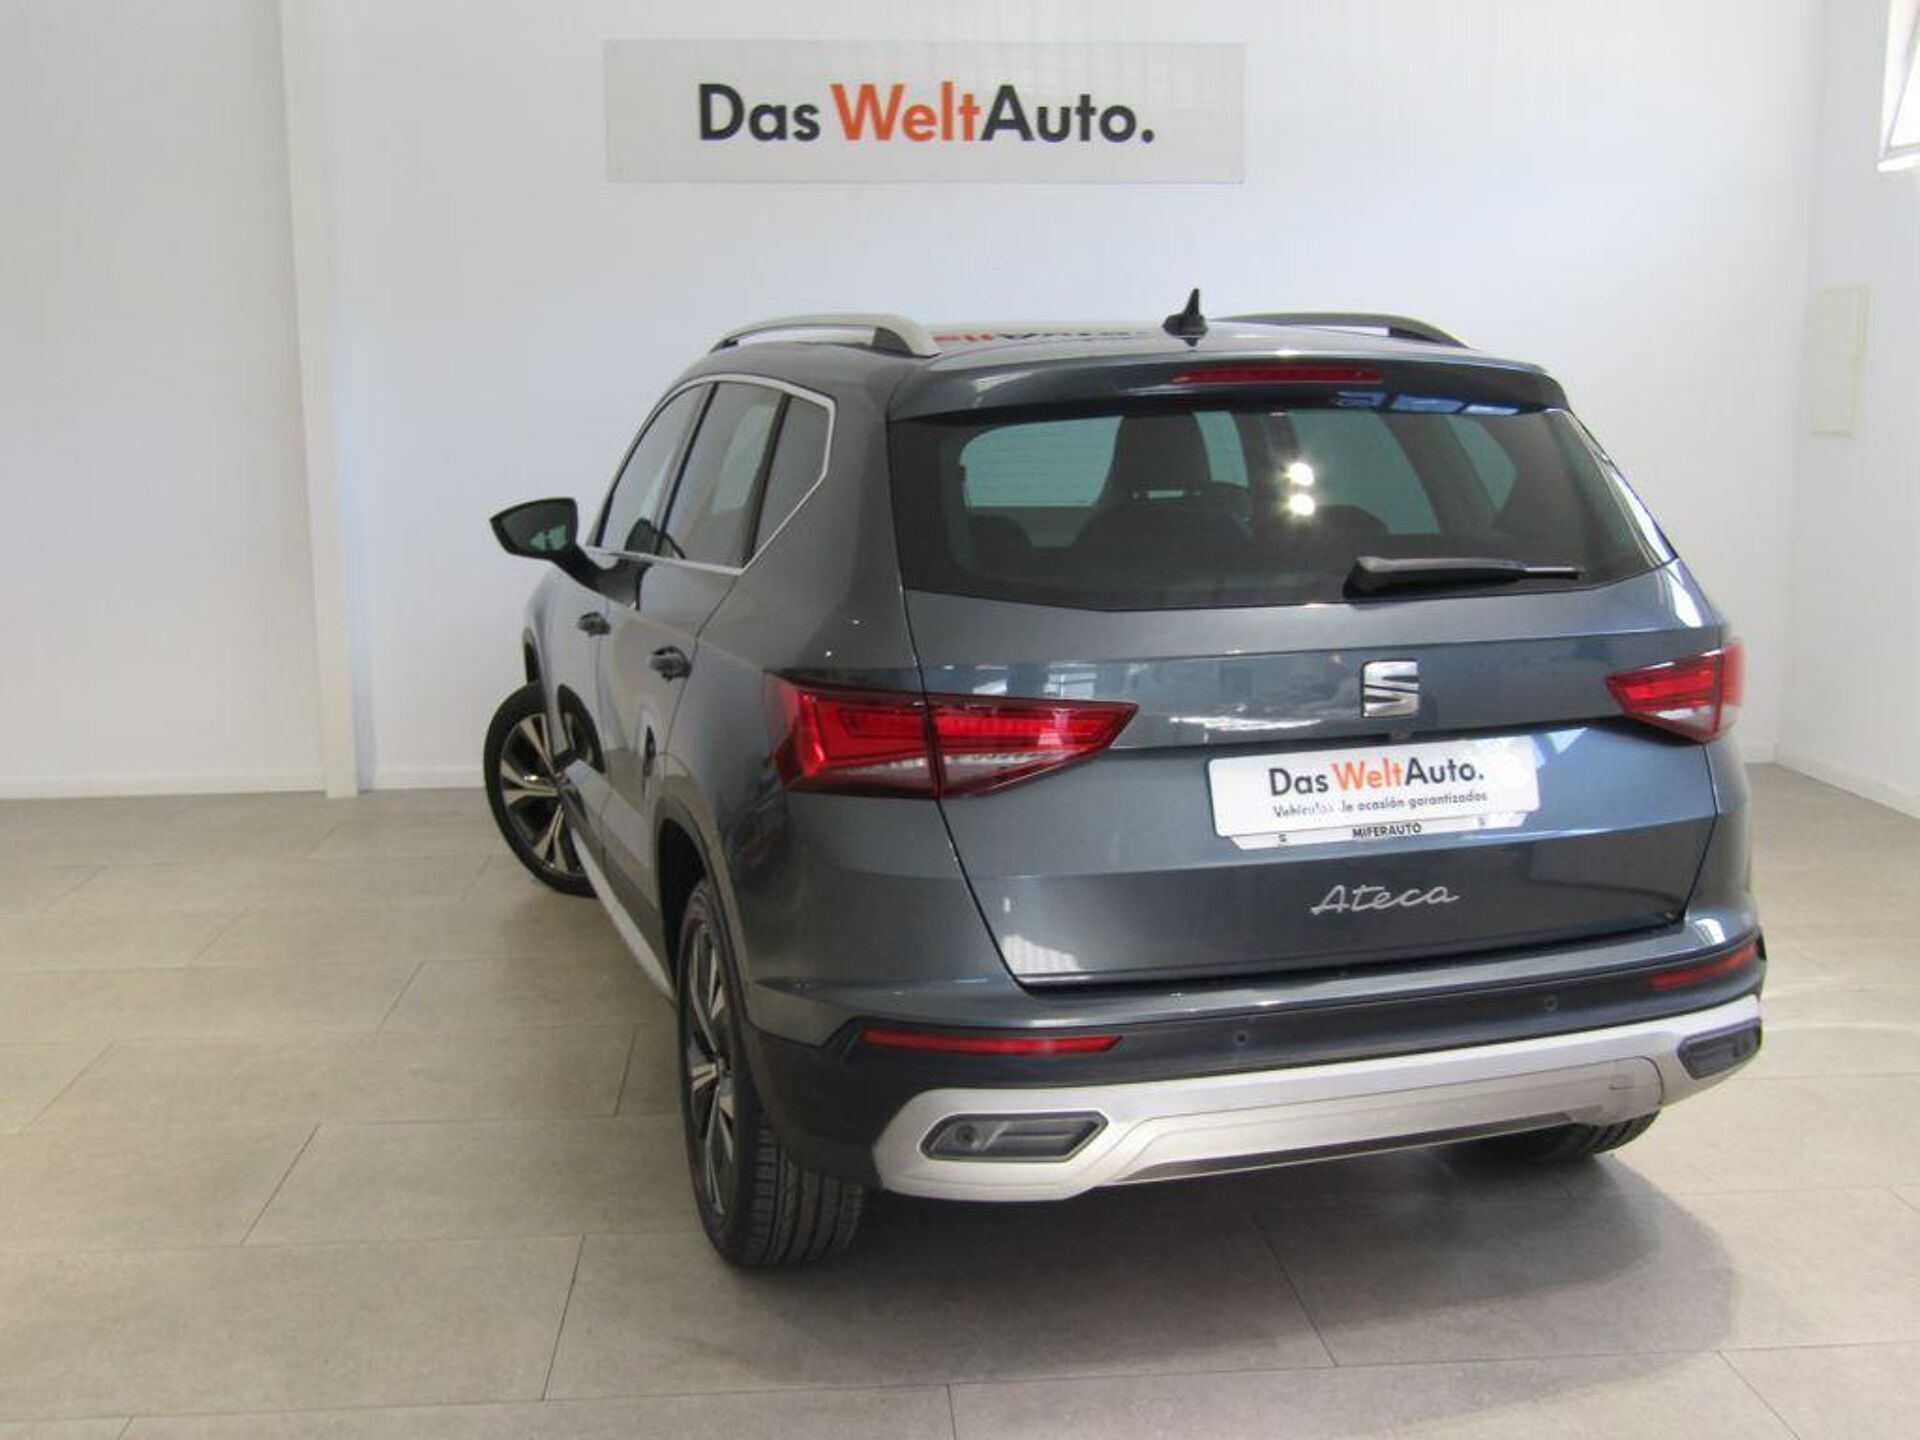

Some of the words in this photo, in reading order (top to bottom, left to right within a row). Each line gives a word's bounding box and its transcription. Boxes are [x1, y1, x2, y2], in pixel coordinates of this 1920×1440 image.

[699, 83, 820, 142] Das
[1268, 768, 1328, 796] Das
[1409, 790, 1488, 810] garantizados
[1352, 822, 1422, 838] MIFERAUTO
[1311, 884, 1460, 915] Ateca
